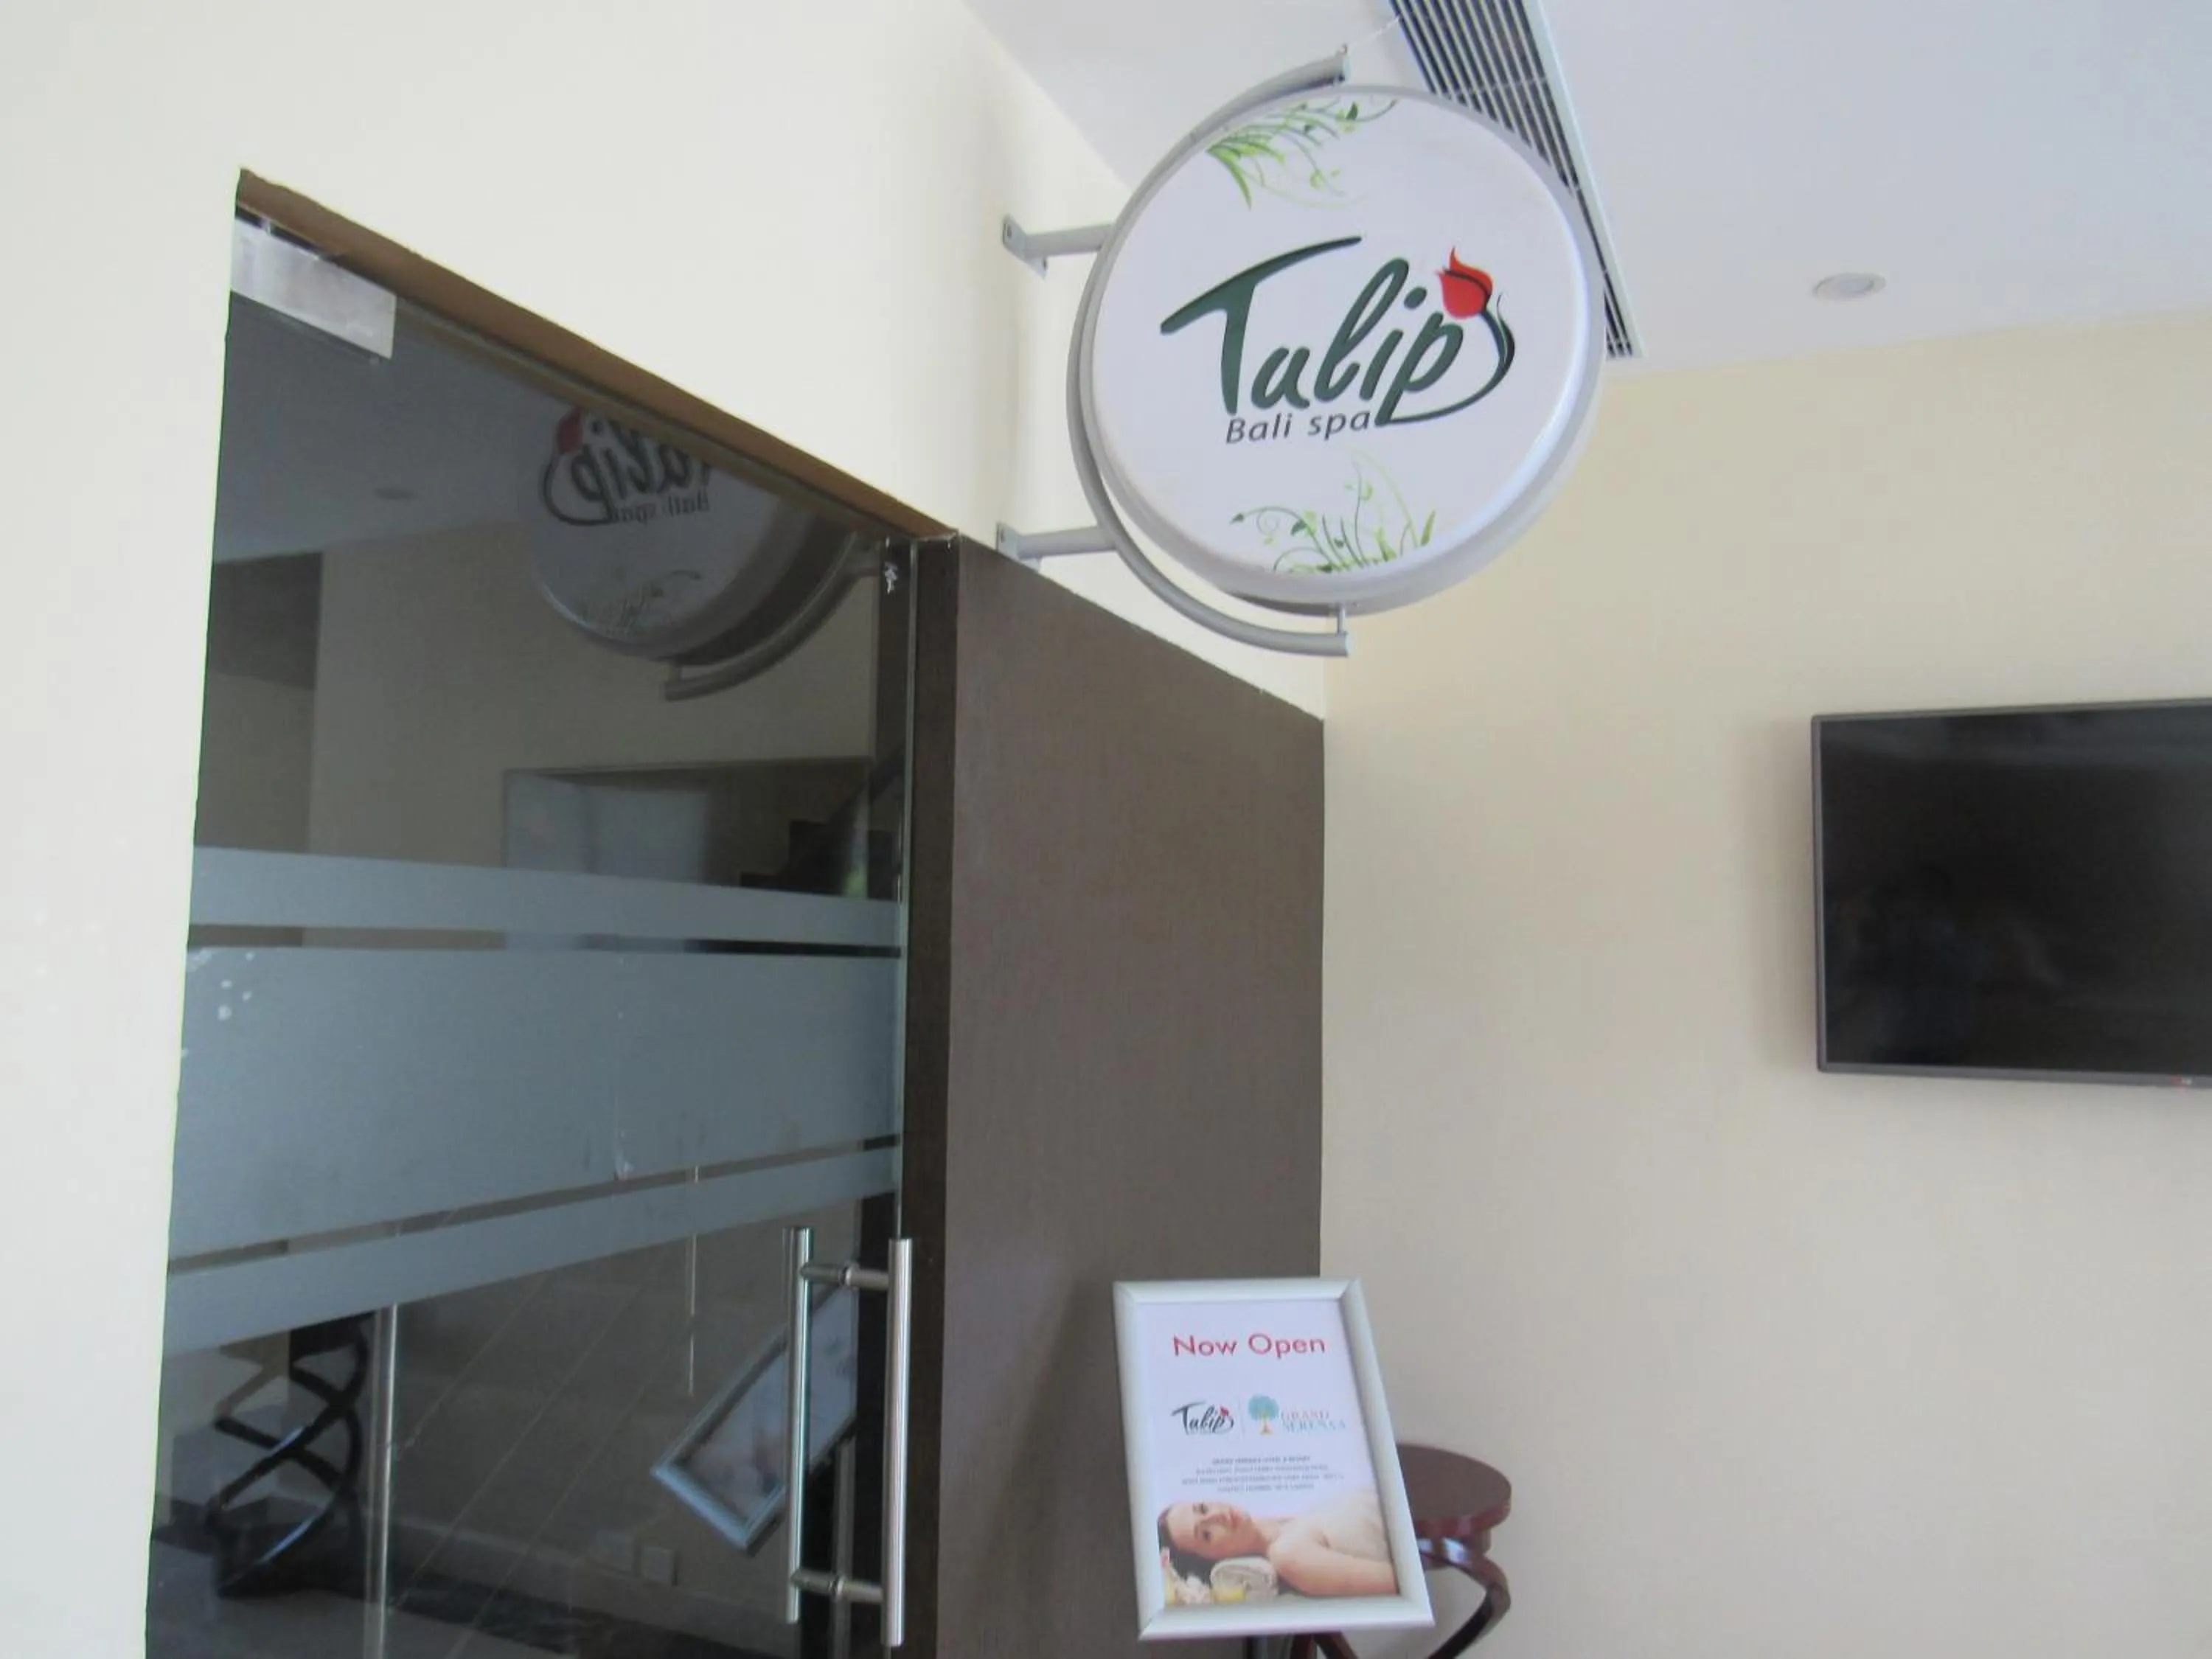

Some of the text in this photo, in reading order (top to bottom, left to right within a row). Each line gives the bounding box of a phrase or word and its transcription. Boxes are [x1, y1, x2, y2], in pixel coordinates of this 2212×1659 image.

[1160, 235, 1515, 426] Tulip
[1225, 411, 1371, 443] Bali spa
[1173, 1332, 1325, 1360] Now Open
[1171, 1400, 1234, 1435] Tulip
